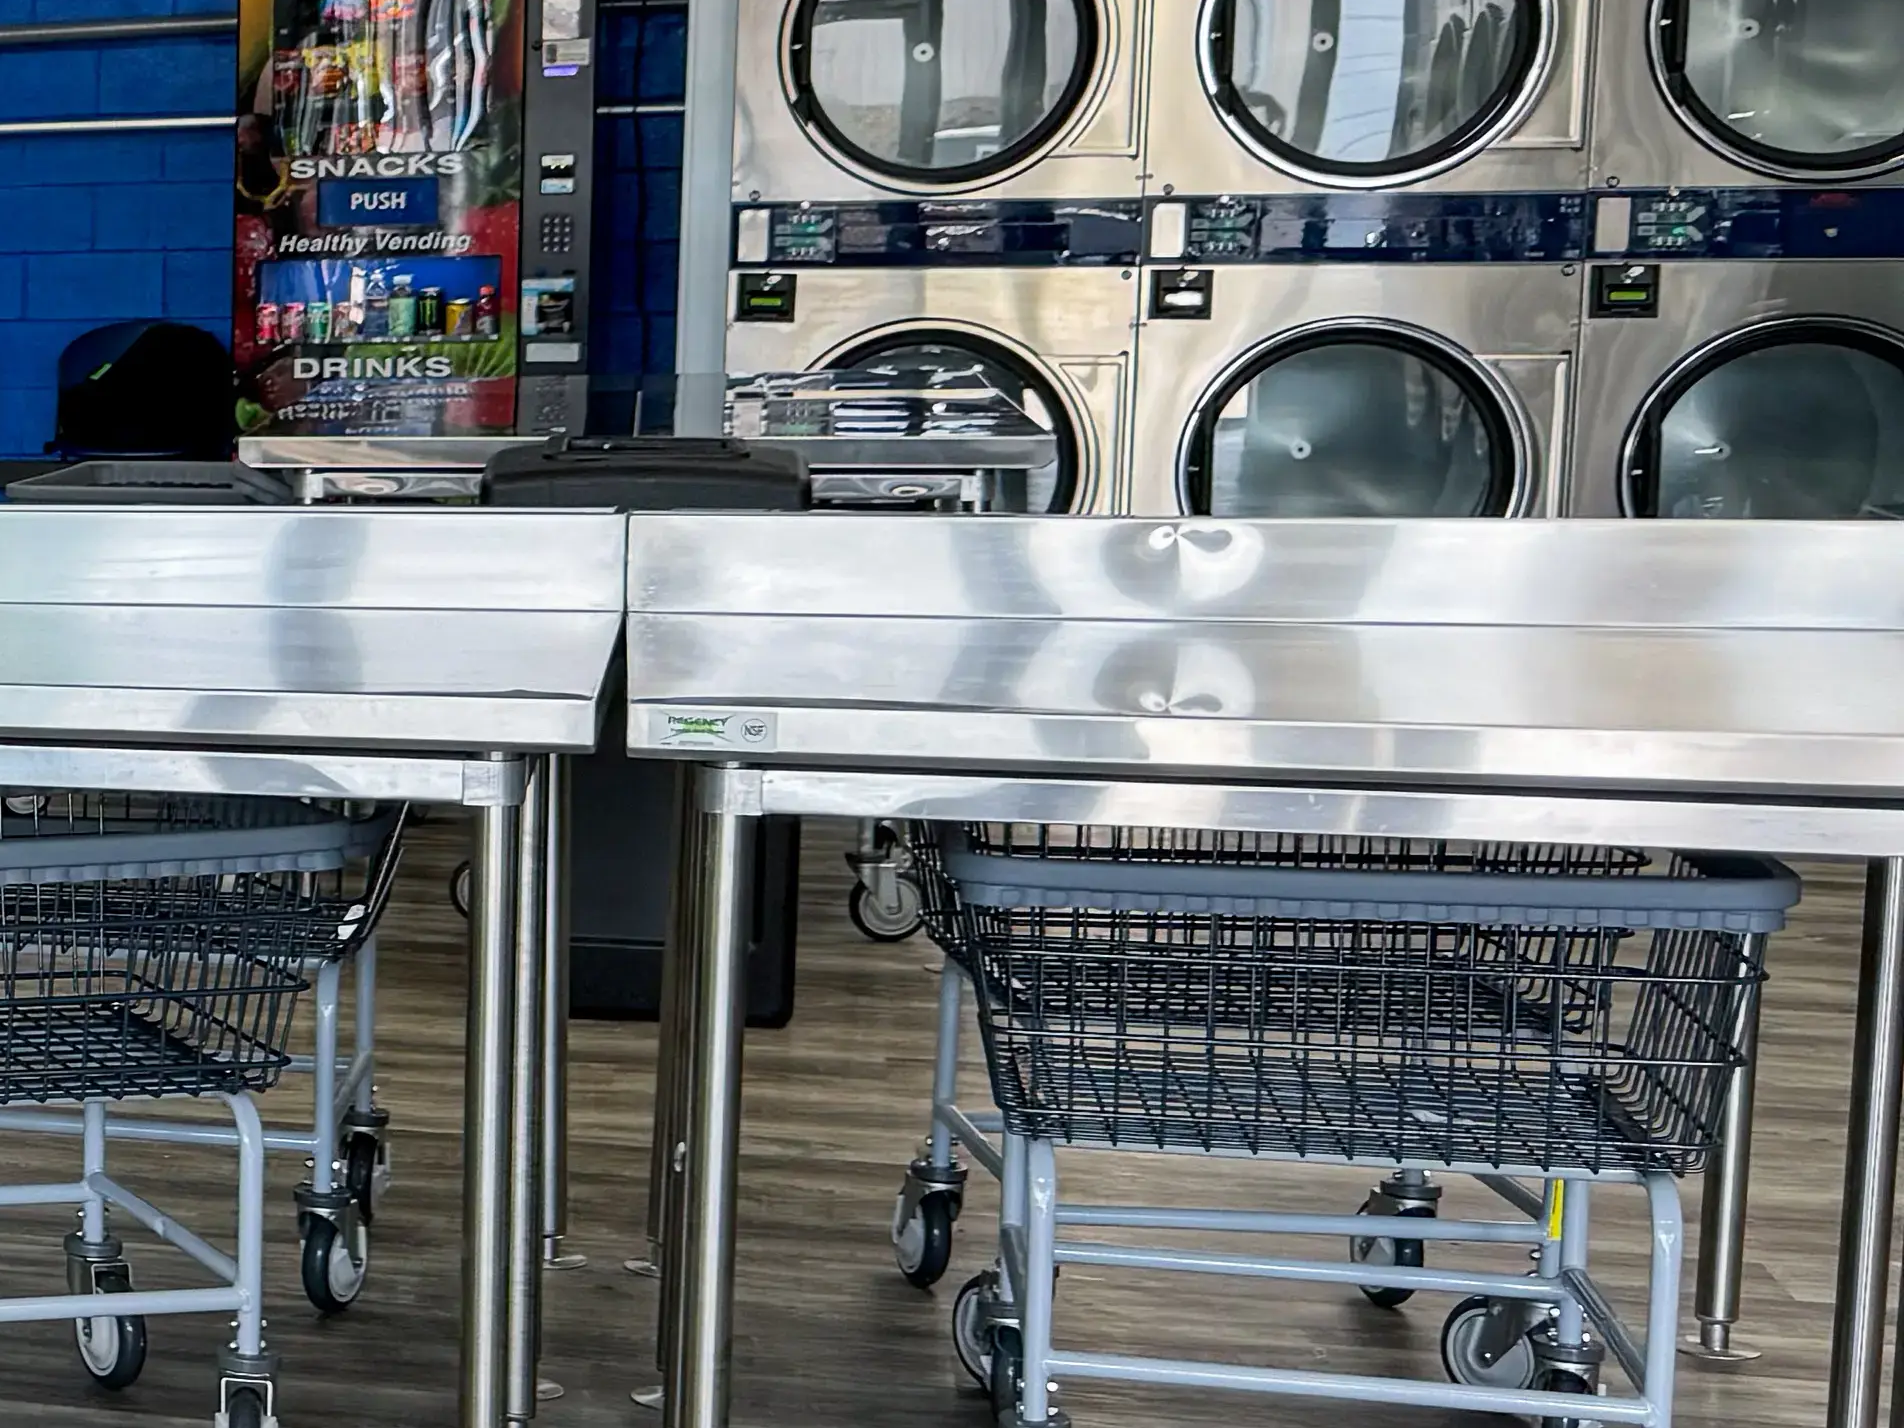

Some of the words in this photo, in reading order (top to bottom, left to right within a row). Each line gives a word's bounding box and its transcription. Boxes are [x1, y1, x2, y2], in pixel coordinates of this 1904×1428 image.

[290, 152, 465, 179] SNACKS
[350, 190, 408, 210] PUSH
[279, 234, 368, 255] Healthy
[374, 230, 472, 252] Vending
[293, 355, 453, 379] DRINKS
[743, 724, 765, 737] NSF
